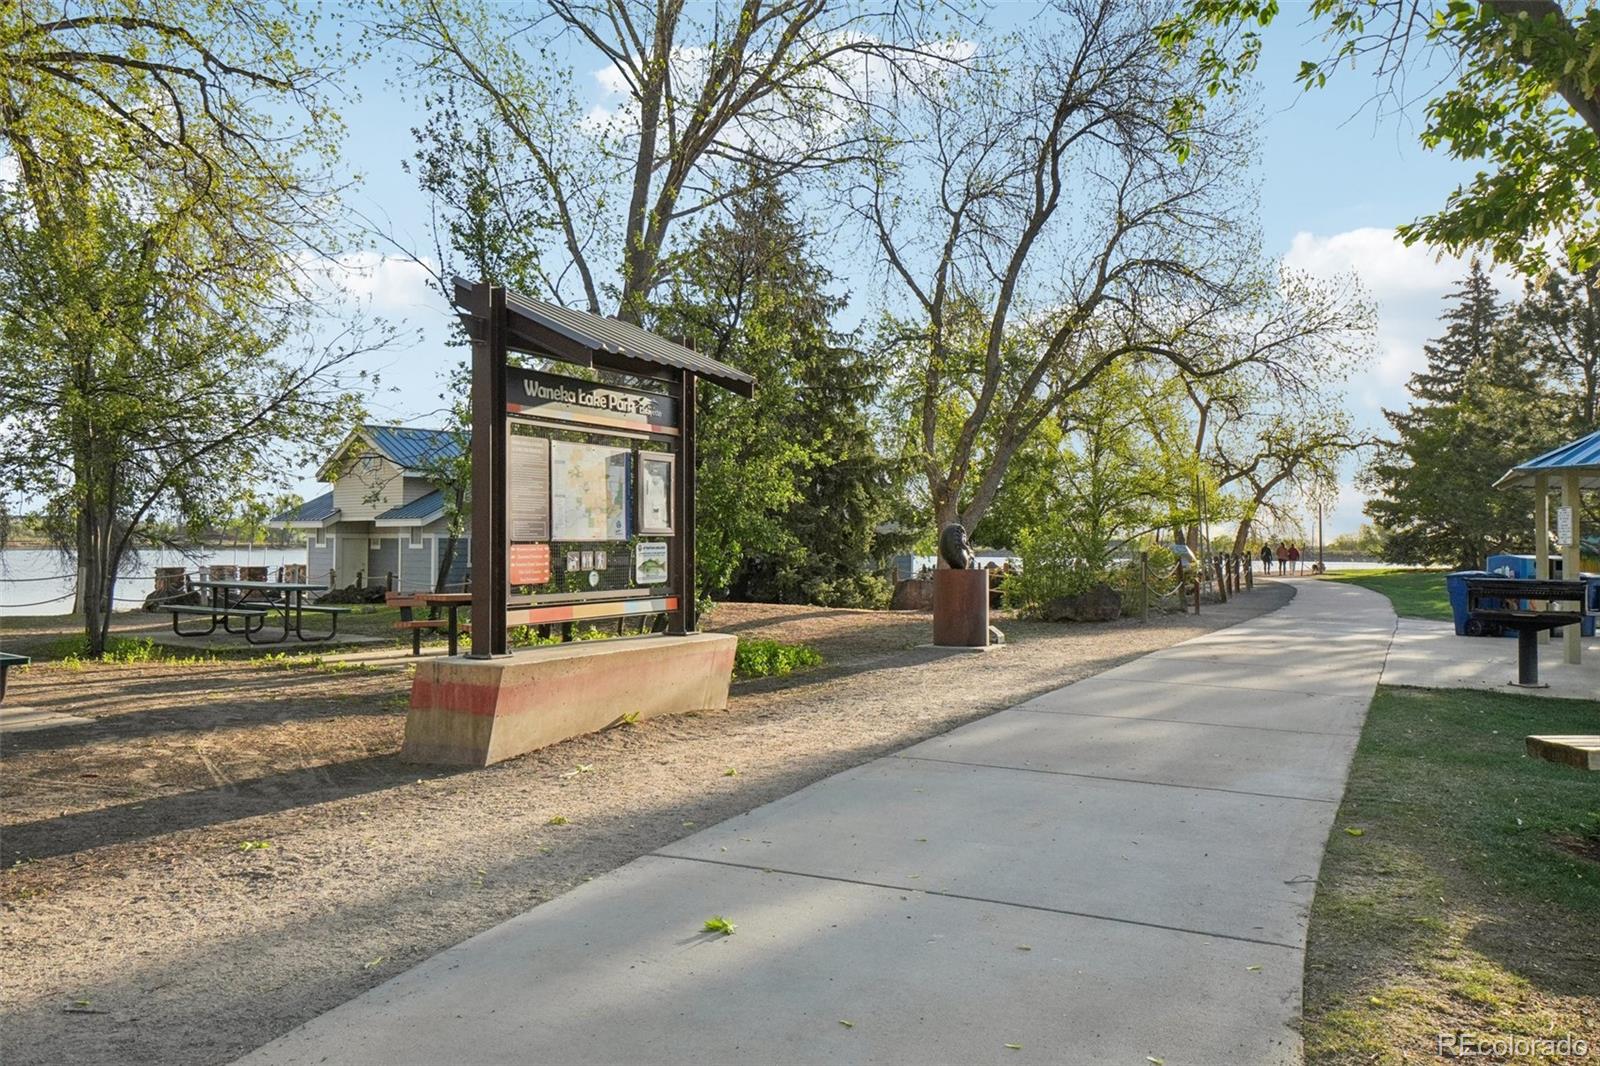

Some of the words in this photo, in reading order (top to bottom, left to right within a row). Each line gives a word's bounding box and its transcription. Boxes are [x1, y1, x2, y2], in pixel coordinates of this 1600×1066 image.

[523, 379, 576, 403] Waneka
[578, 388, 607, 408] Lake
[609, 394, 637, 414] Park
